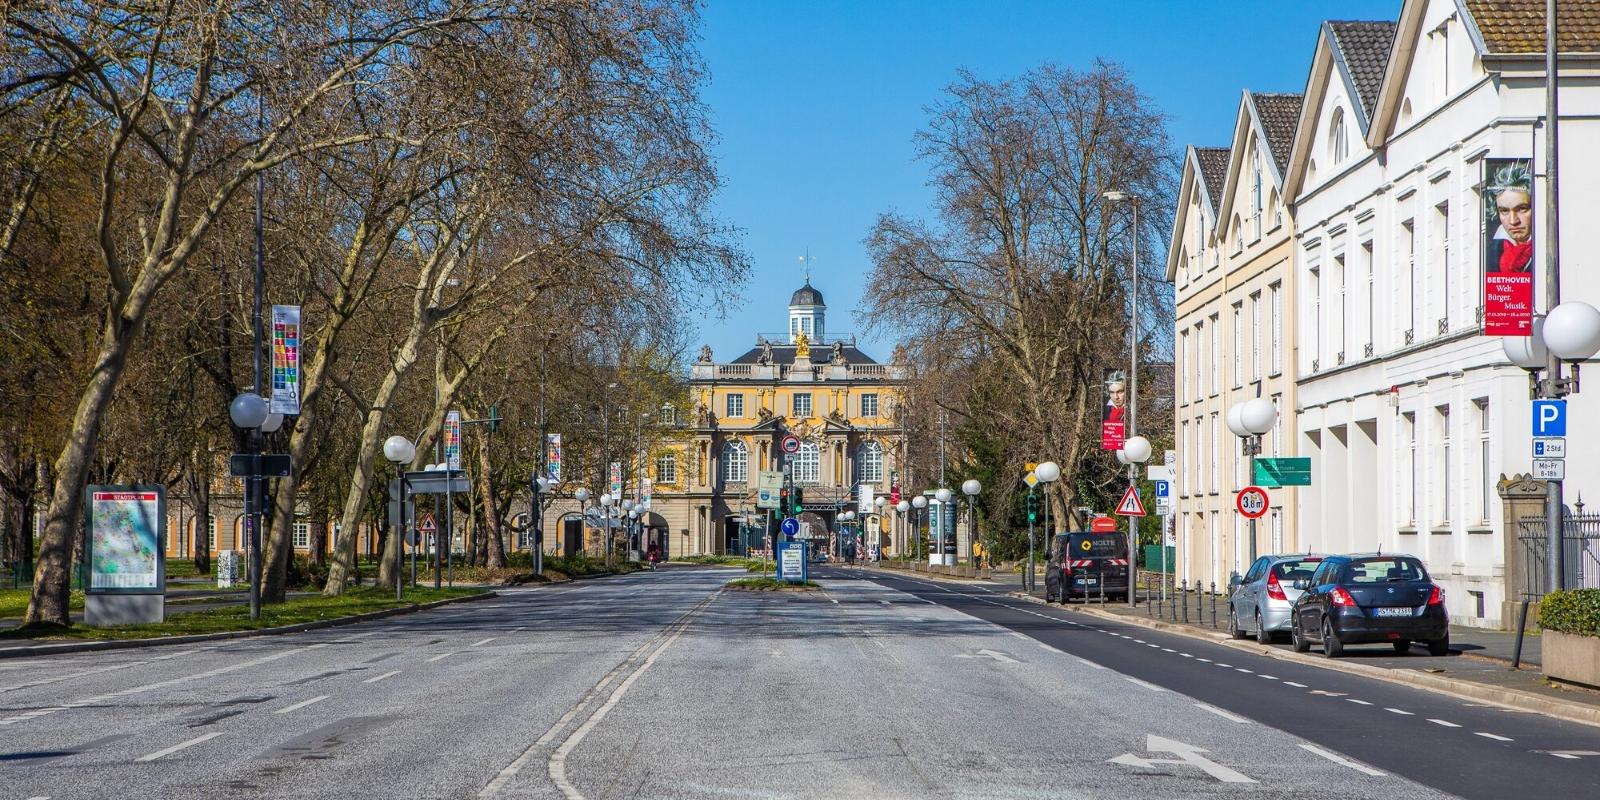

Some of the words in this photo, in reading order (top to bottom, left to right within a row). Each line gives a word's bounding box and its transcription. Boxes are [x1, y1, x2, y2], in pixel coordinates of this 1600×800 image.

[1487, 276, 1530, 284] BEETHOVEN
[1488, 293, 1511, 303] Bürger.
[1504, 302, 1527, 310] Musik.
[1540, 404, 1559, 433] P
[1158, 483, 1166, 496] P
